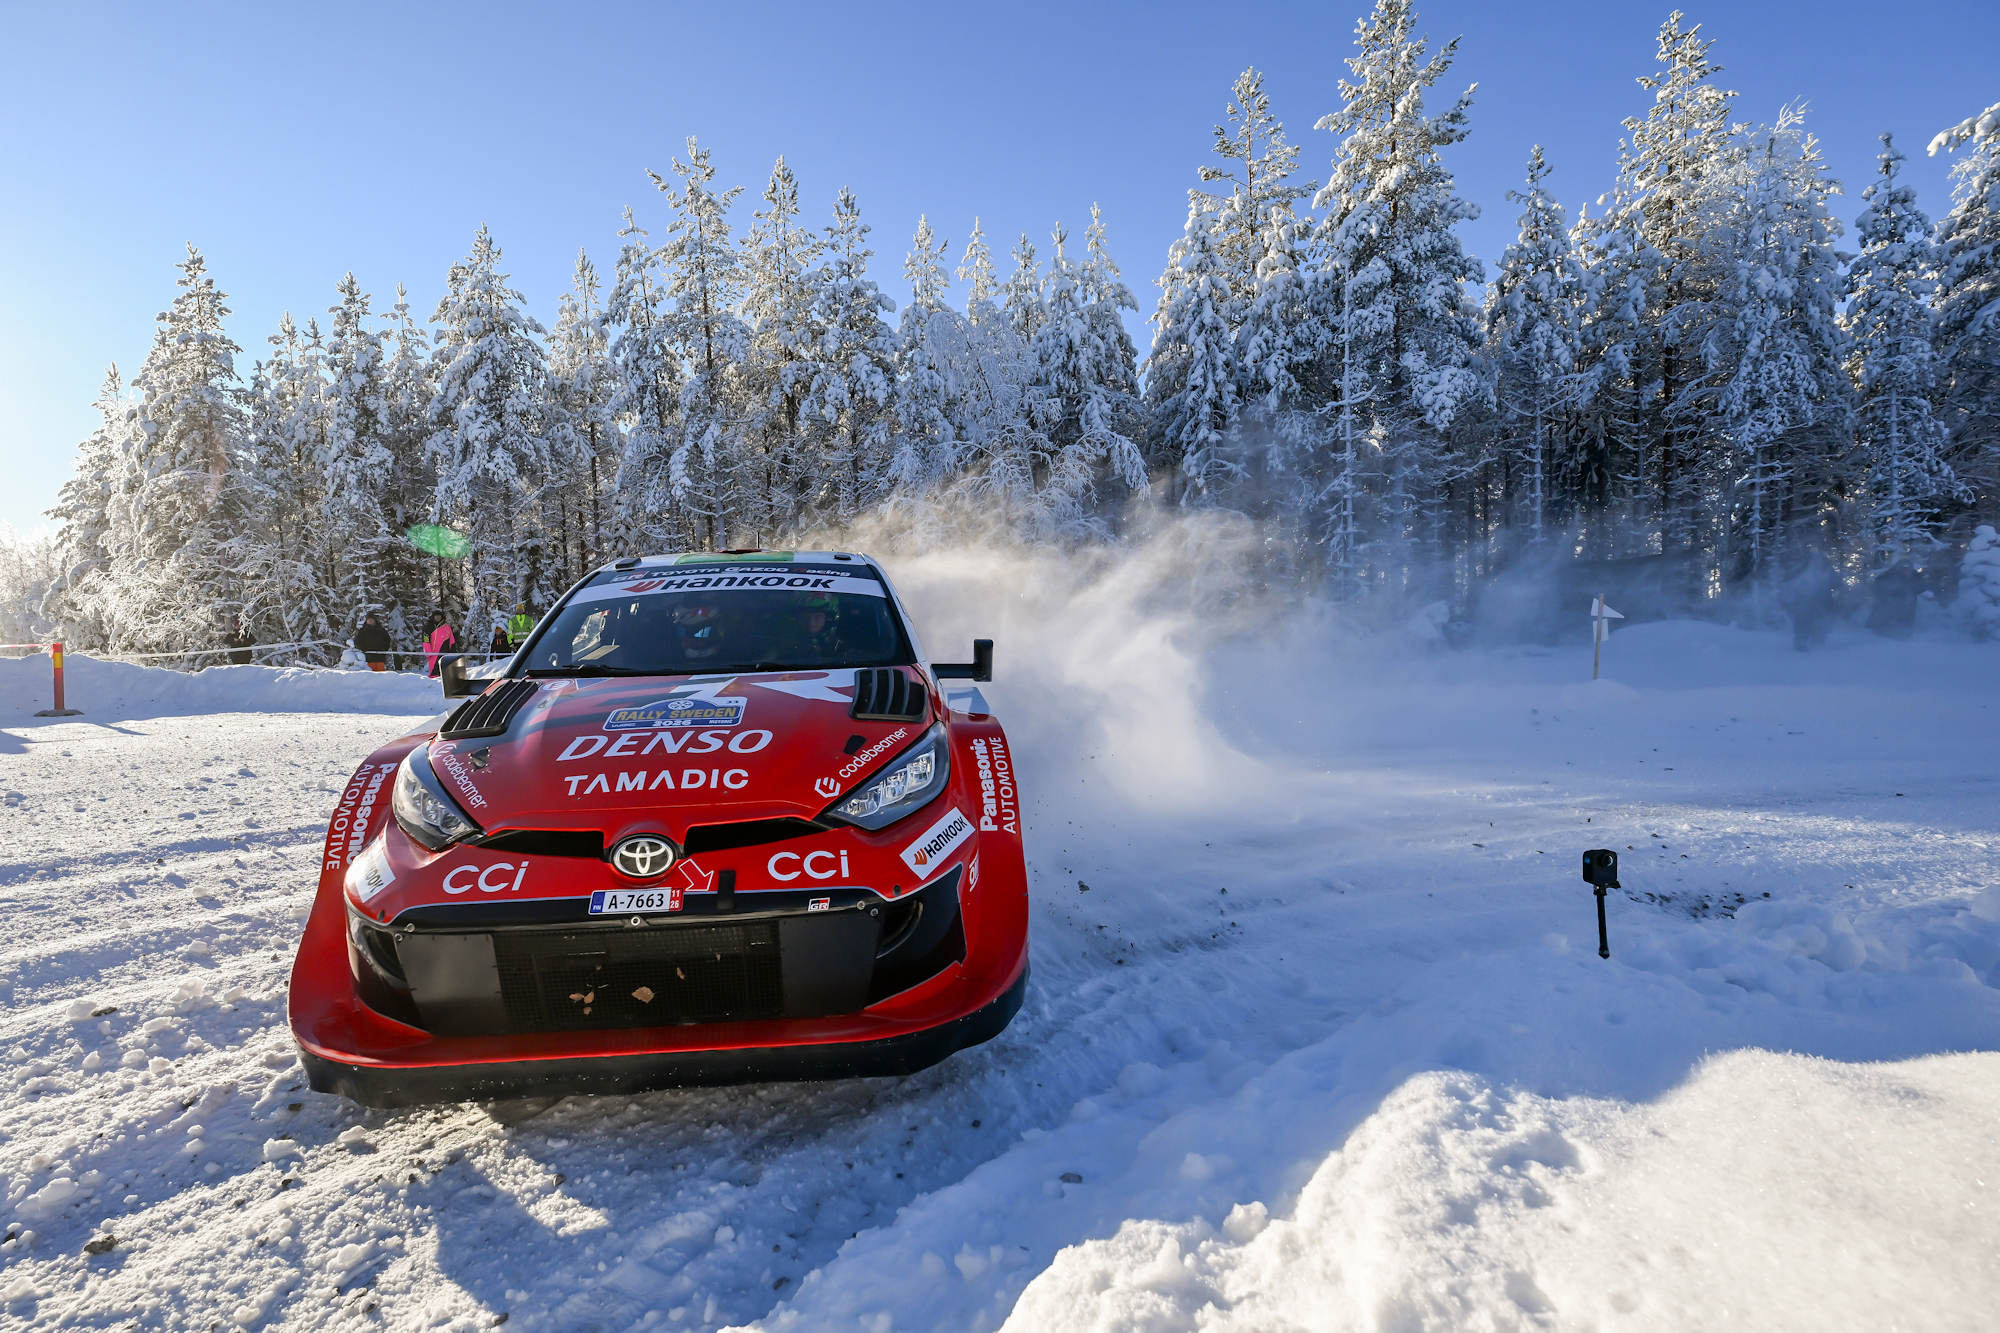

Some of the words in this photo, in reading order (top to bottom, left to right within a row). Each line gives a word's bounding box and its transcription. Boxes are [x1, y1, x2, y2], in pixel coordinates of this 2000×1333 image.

[651, 567, 721, 578] TOYOTA
[615, 710, 667, 721] RALLY
[669, 707, 737, 719] SWEDEN
[652, 719, 692, 727] 2026
[555, 729, 774, 762] DENSO
[839, 727, 908, 779] codebeamer
[442, 753, 486, 809] codebeamer
[563, 768, 750, 796] TAMADIC
[972, 738, 999, 832] Panasonic
[989, 736, 1017, 834] AUTOMOTIVE
[326, 763, 375, 871] AUTOMOTIVE
[608, 893, 664, 910] A-7663
[670, 900, 680, 908] 26
